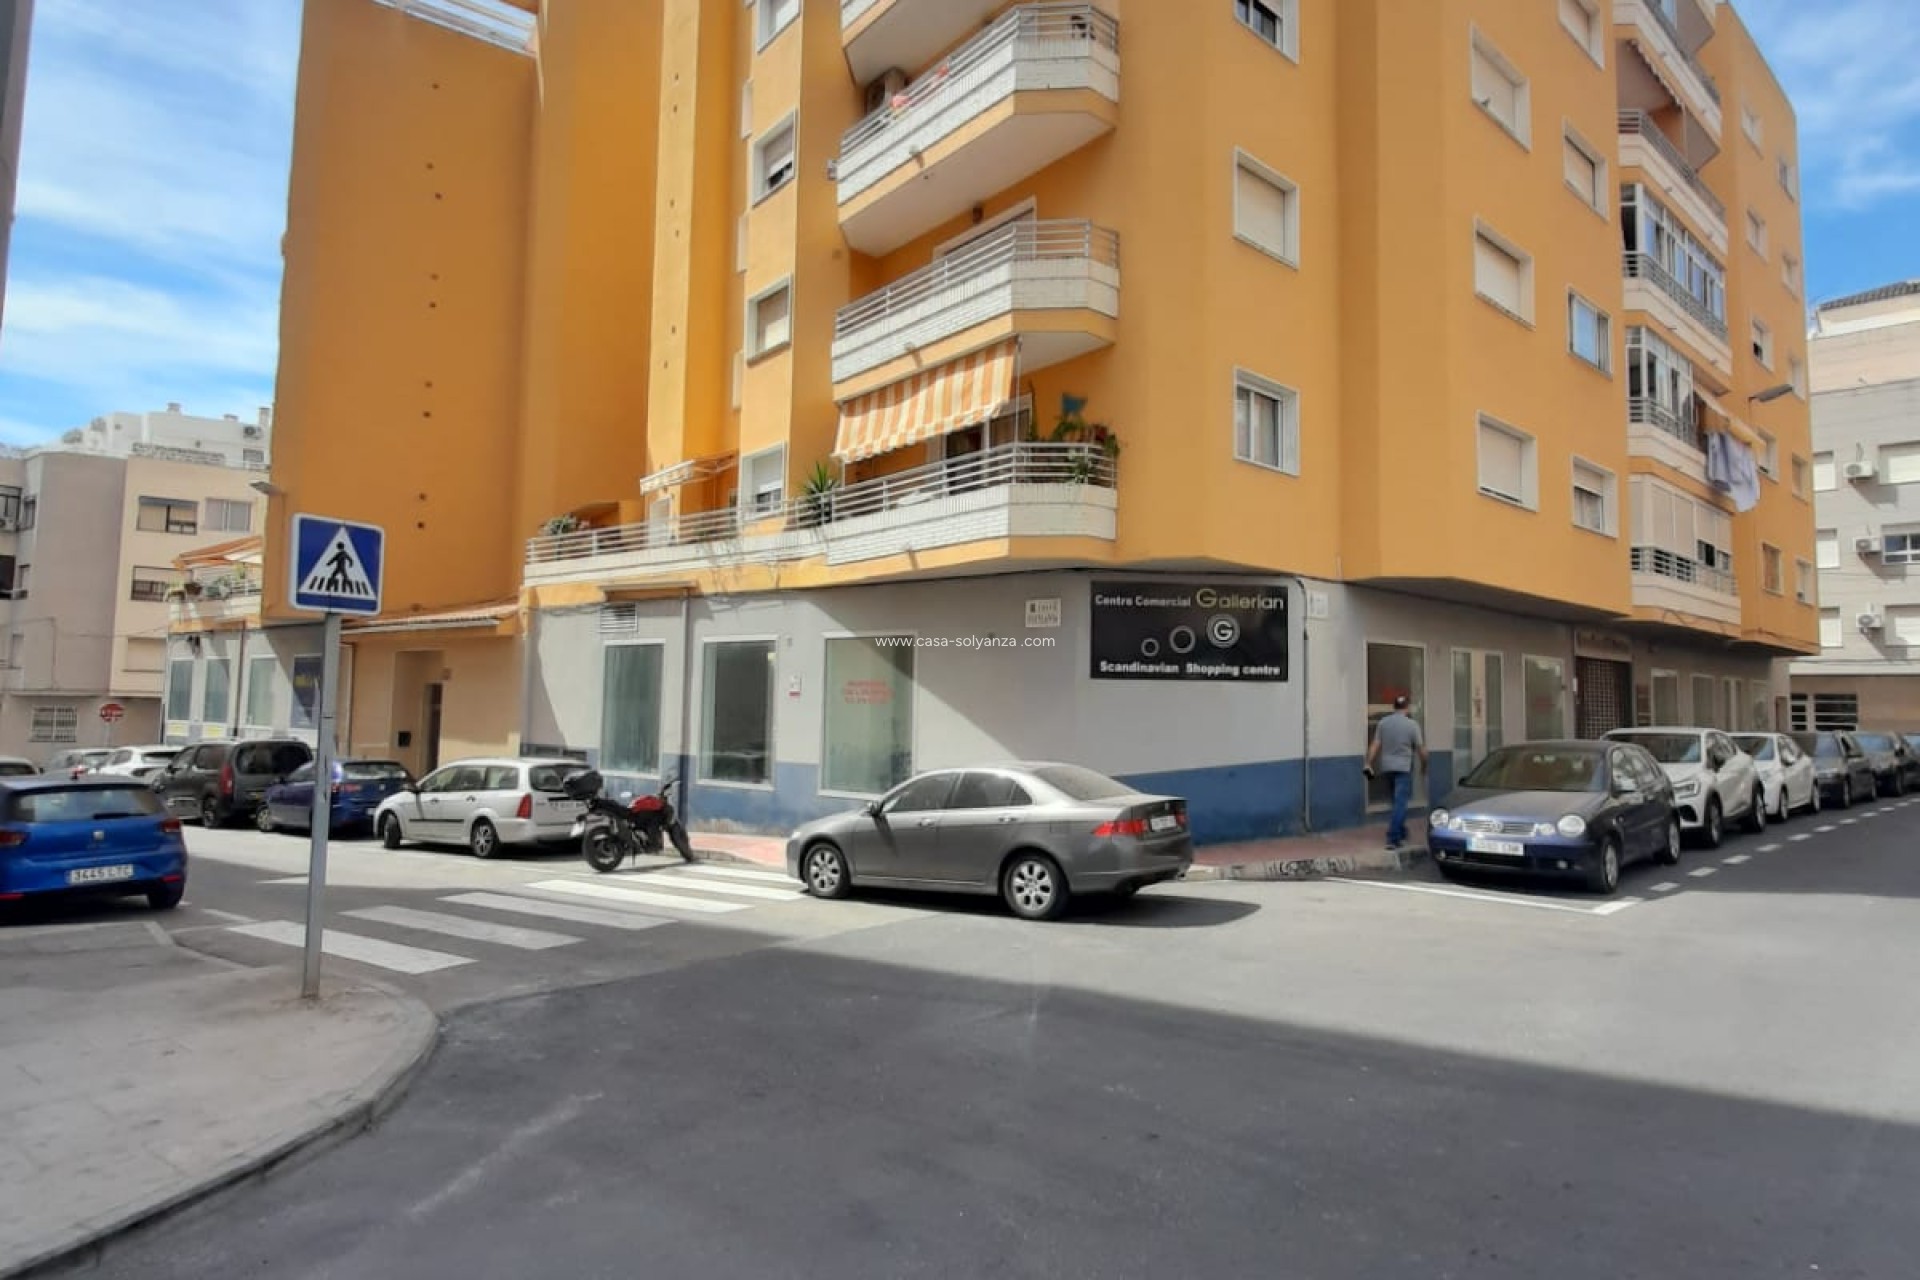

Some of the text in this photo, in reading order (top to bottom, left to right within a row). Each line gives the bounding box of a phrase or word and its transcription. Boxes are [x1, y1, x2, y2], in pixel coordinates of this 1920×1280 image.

[1136, 595, 1191, 607] Comercial
[1196, 588, 1284, 609] Gallerian
[1213, 621, 1233, 641] G
[1101, 661, 1281, 677] Scandinavian Shopping centre
